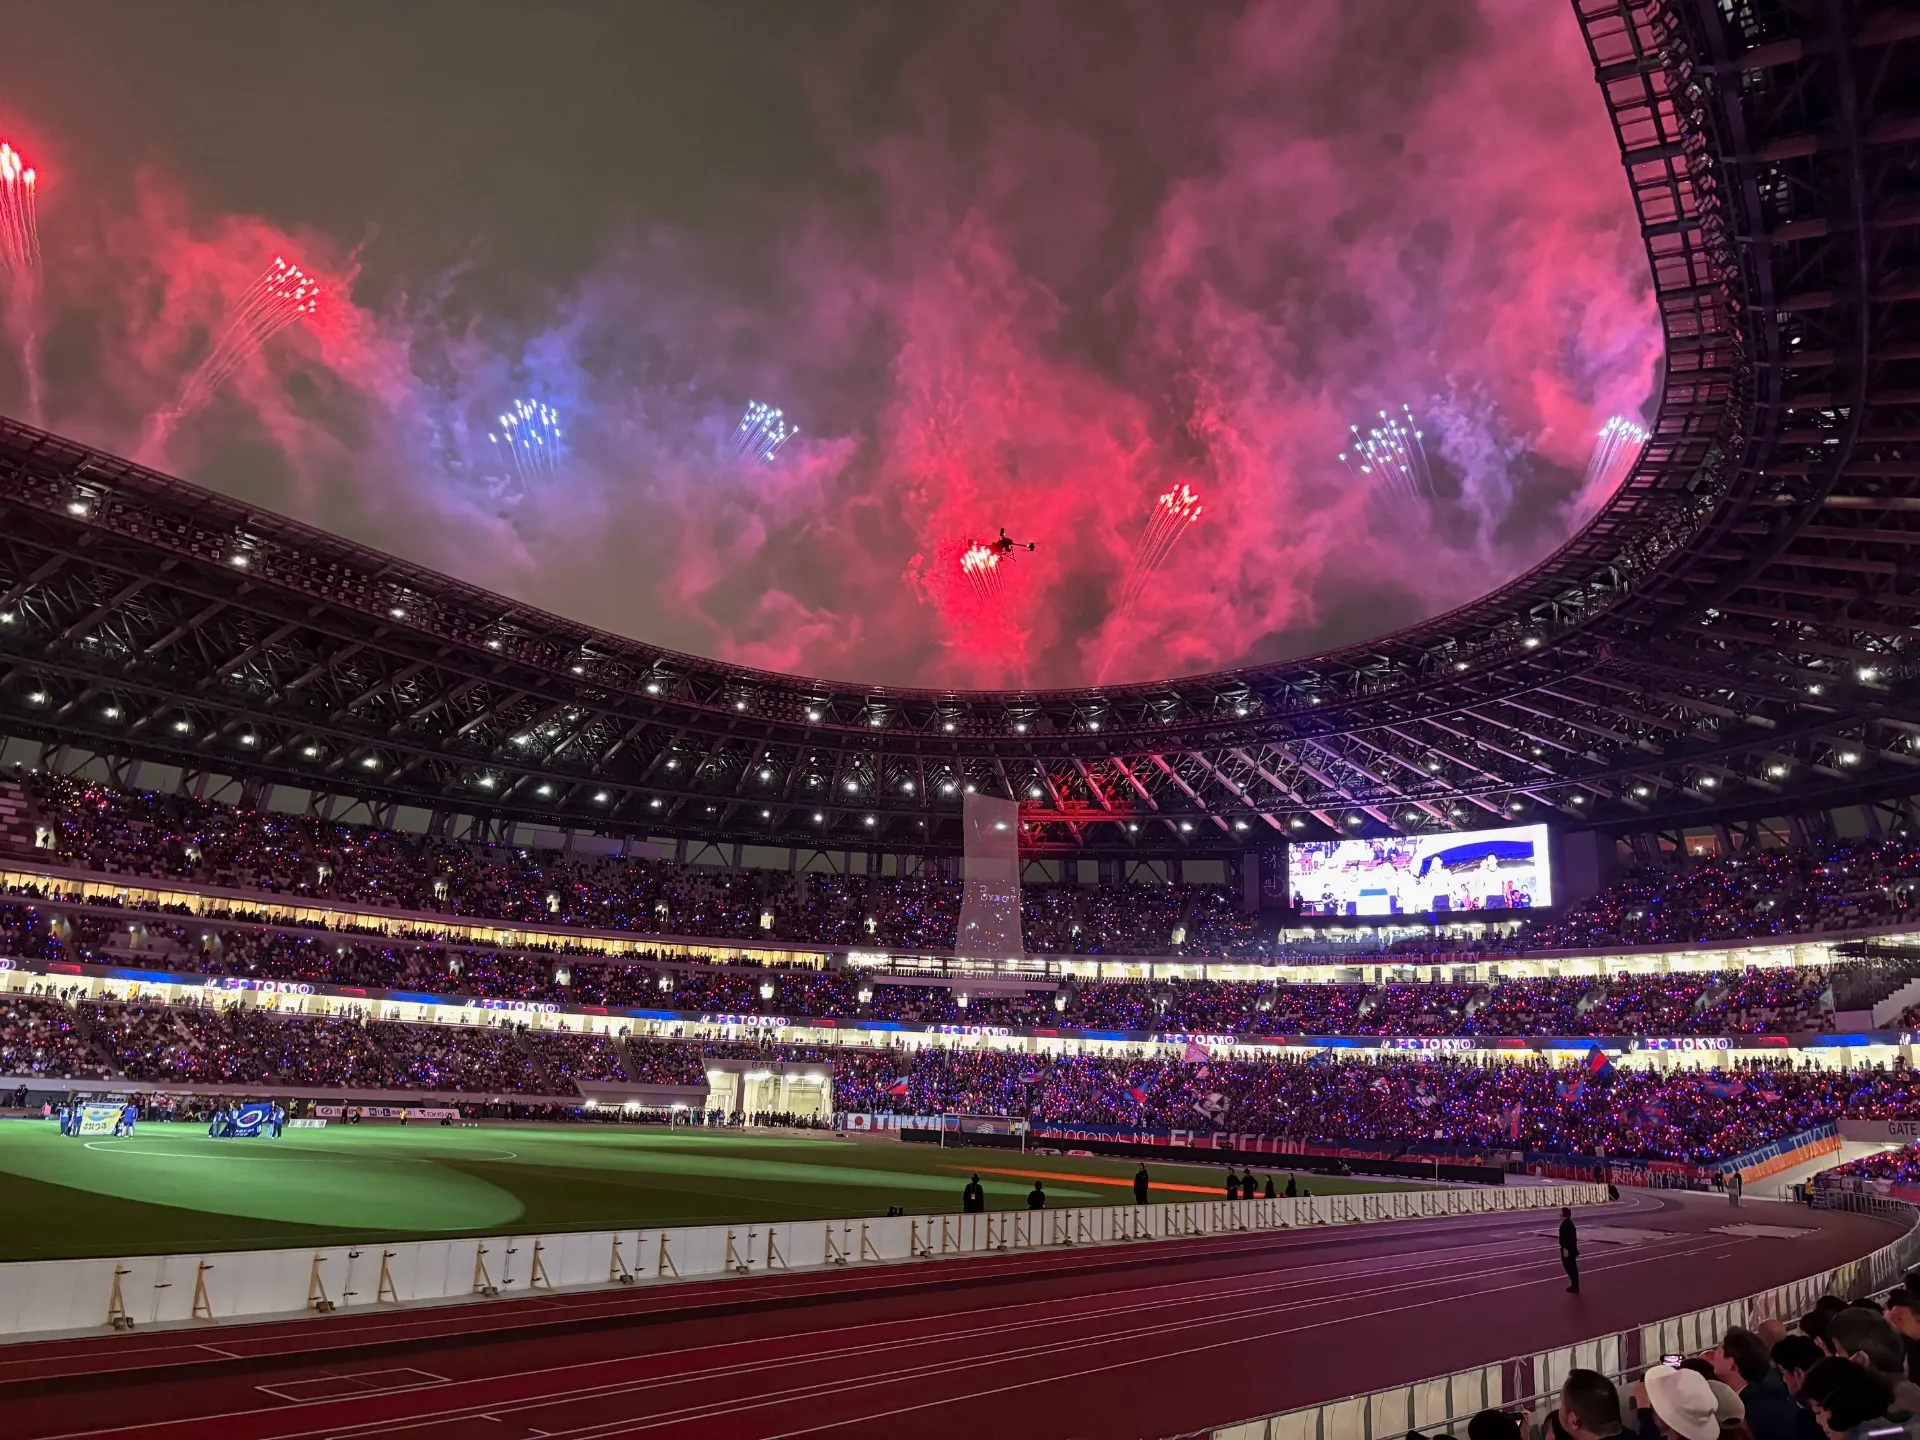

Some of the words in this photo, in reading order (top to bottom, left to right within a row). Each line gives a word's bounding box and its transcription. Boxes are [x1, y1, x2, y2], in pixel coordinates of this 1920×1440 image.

[253, 980, 310, 994] TOKYO
[506, 1001, 556, 1013] TOKYO
[740, 1016, 788, 1027] TOKYO
[962, 1026, 1009, 1036] TOKYO
[1187, 1035, 1235, 1045] TOKYO
[1420, 1039, 1471, 1050] TOKYO
[1671, 1038, 1729, 1051] TOKYO
[751, 1061, 777, 1071] GATE
[1888, 1122, 1918, 1136] GATE
